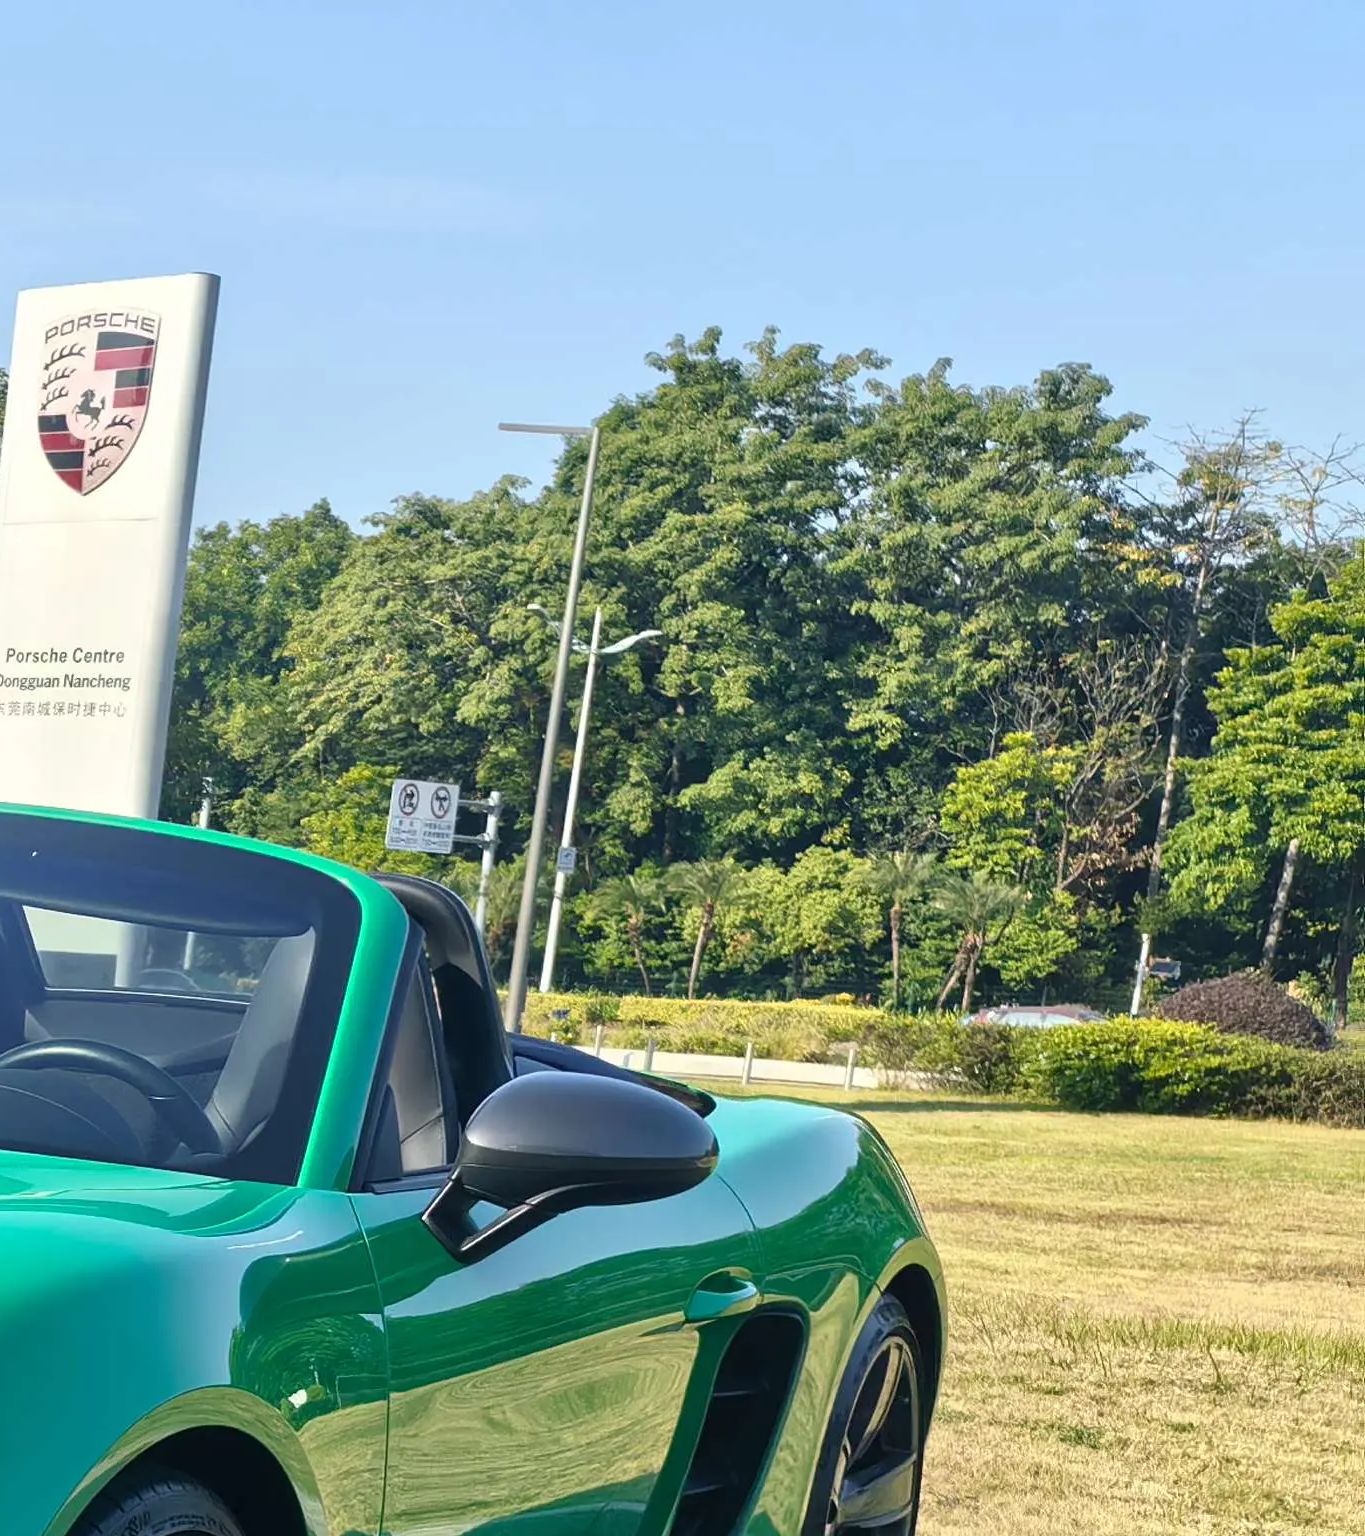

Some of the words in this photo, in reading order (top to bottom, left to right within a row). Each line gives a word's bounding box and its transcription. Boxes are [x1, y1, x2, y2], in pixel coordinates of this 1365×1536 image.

[44, 312, 156, 345] PORSCHE
[5, 648, 68, 664] Porsche
[72, 647, 125, 664] Centre
[63, 673, 131, 692] Nancheng
